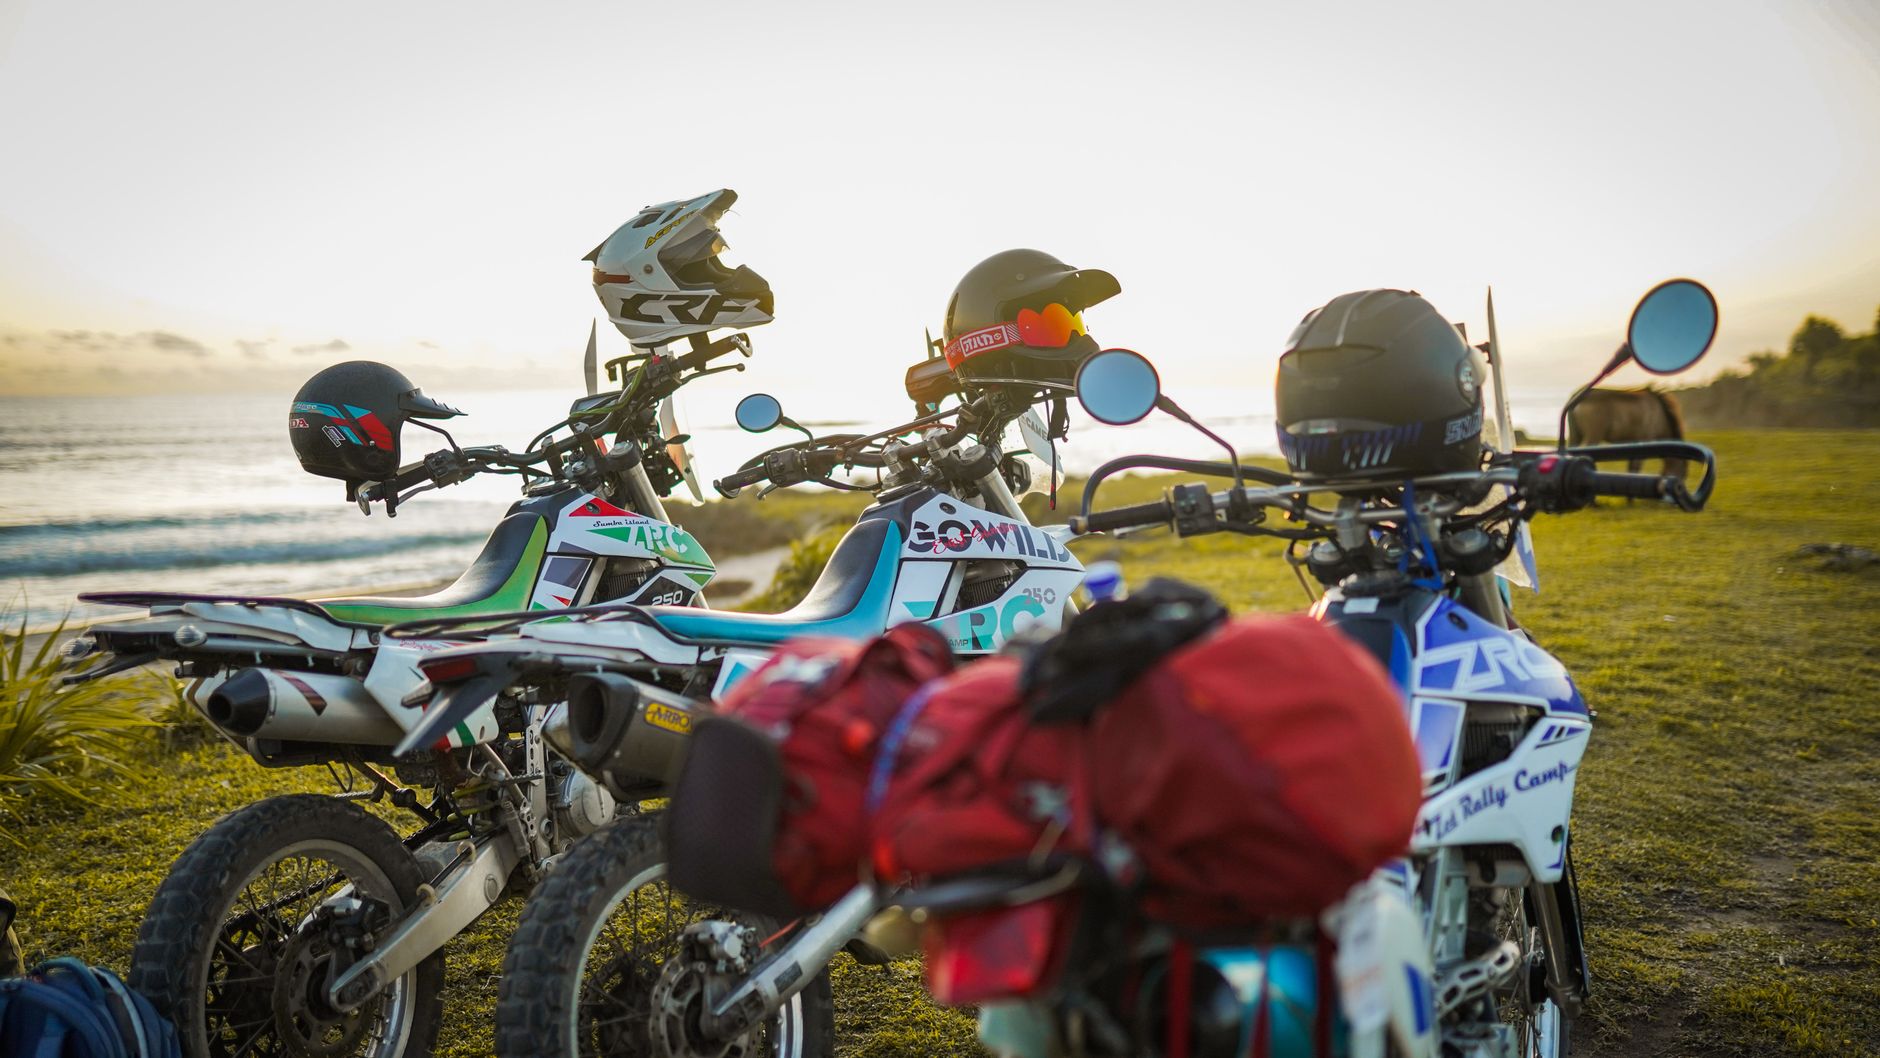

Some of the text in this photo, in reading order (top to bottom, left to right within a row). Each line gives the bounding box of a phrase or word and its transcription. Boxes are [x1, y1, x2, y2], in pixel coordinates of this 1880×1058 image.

[620, 294, 760, 325] CRF
[290, 418, 309, 428] DA
[1026, 416, 1049, 442] CAME
[652, 590, 683, 607] 250
[1022, 588, 1056, 604] 250
[950, 639, 968, 647] AMP
[648, 706, 690, 728] ARRO
[1458, 785, 1508, 821] Rally
[1514, 760, 1573, 791] Camp
